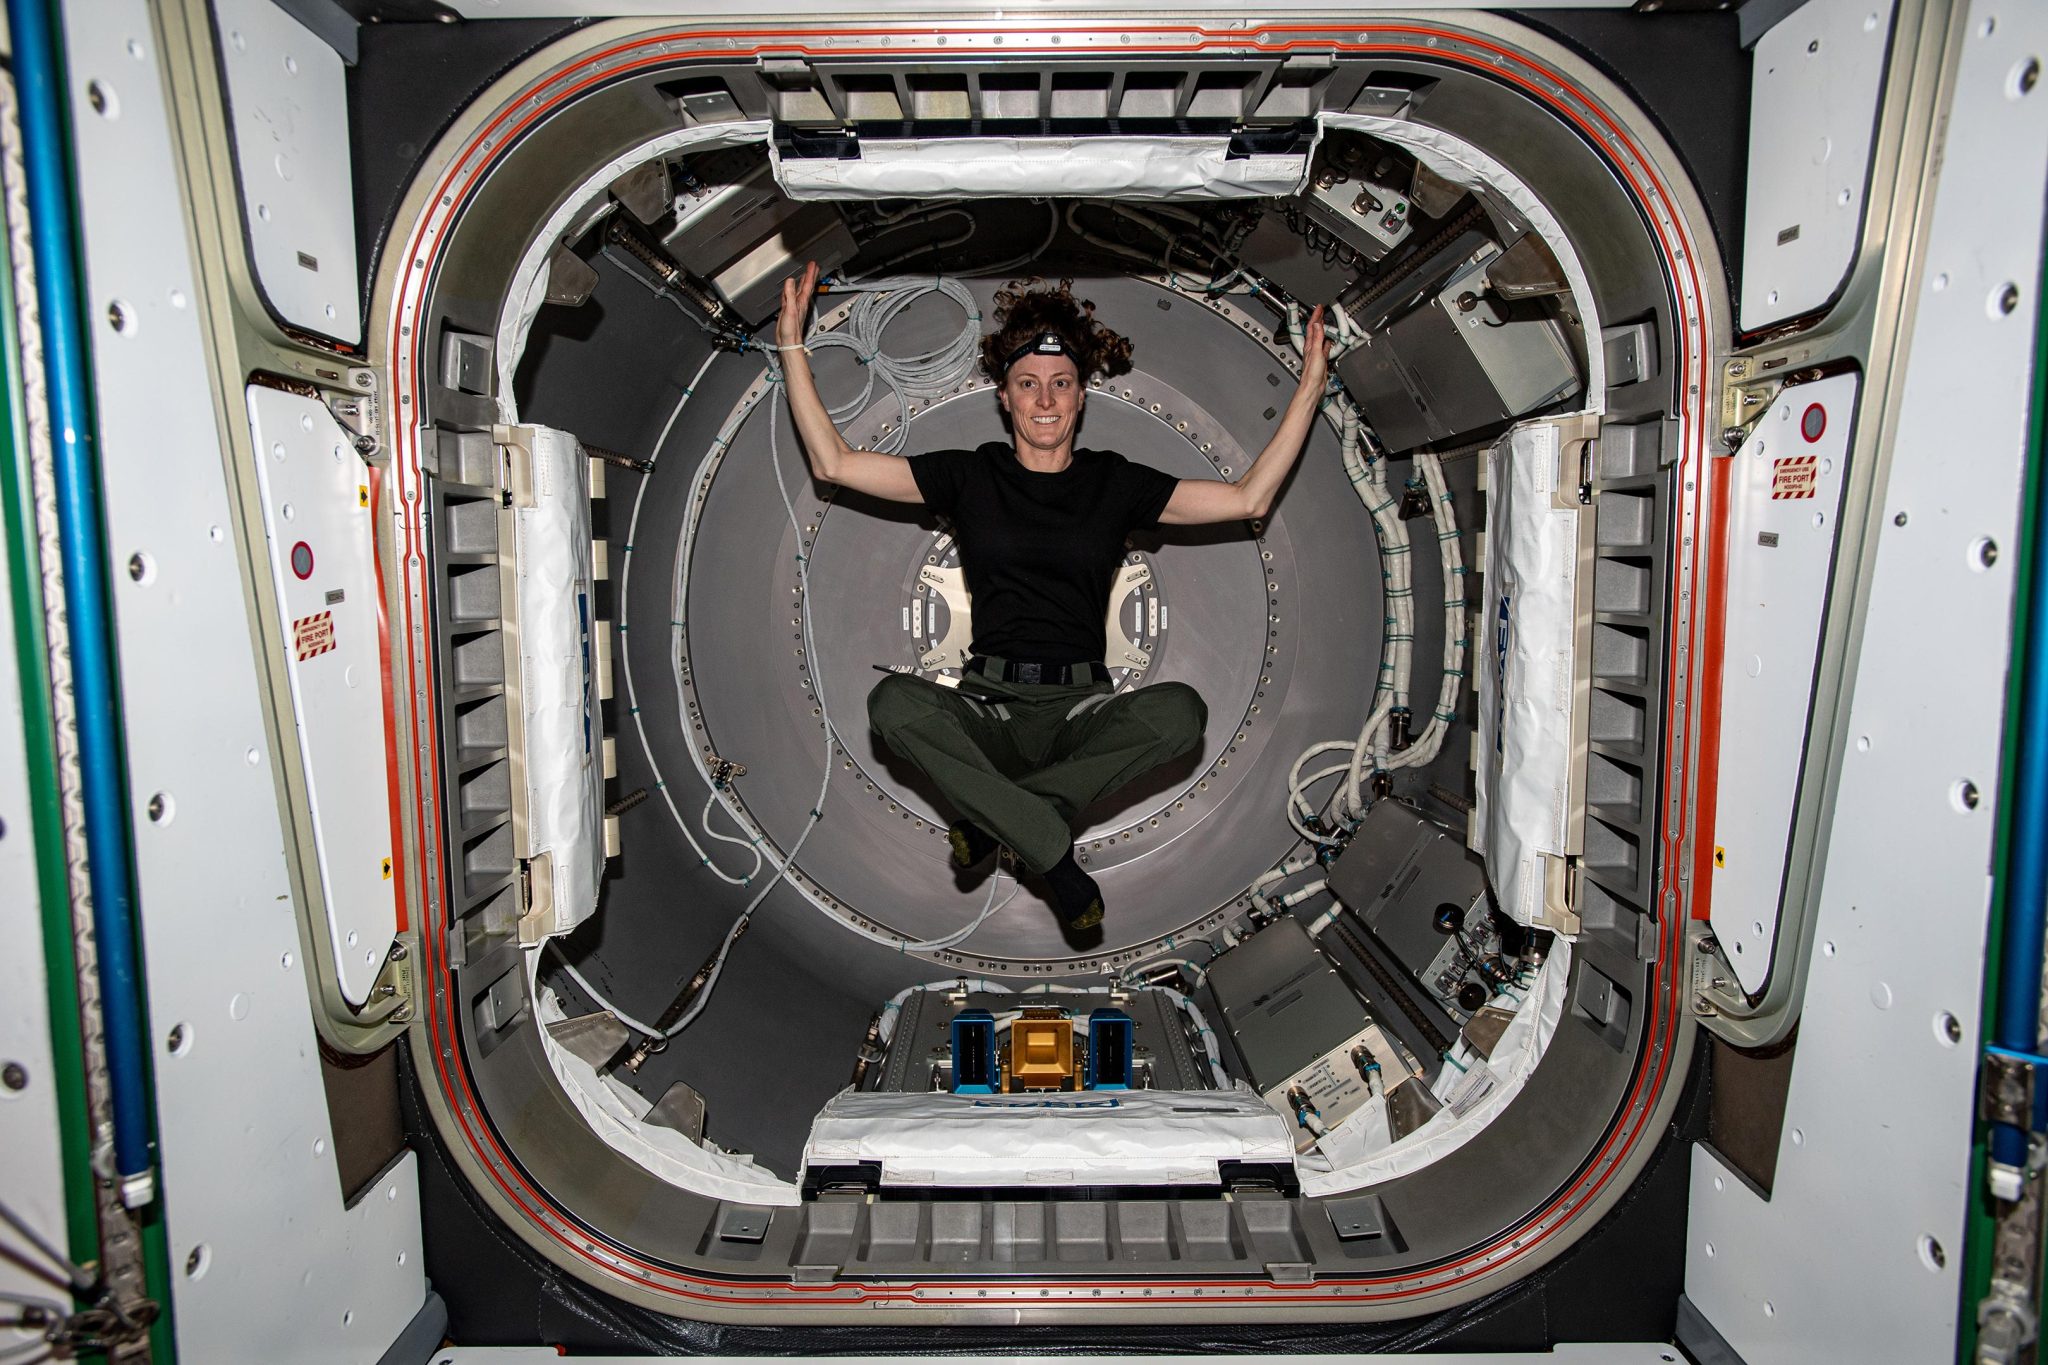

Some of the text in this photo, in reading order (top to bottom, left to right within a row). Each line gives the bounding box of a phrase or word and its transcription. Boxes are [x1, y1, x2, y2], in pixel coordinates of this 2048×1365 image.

[1779, 474, 1810, 484] FIRE PORT
[302, 629, 328, 644] FIRE PORT
